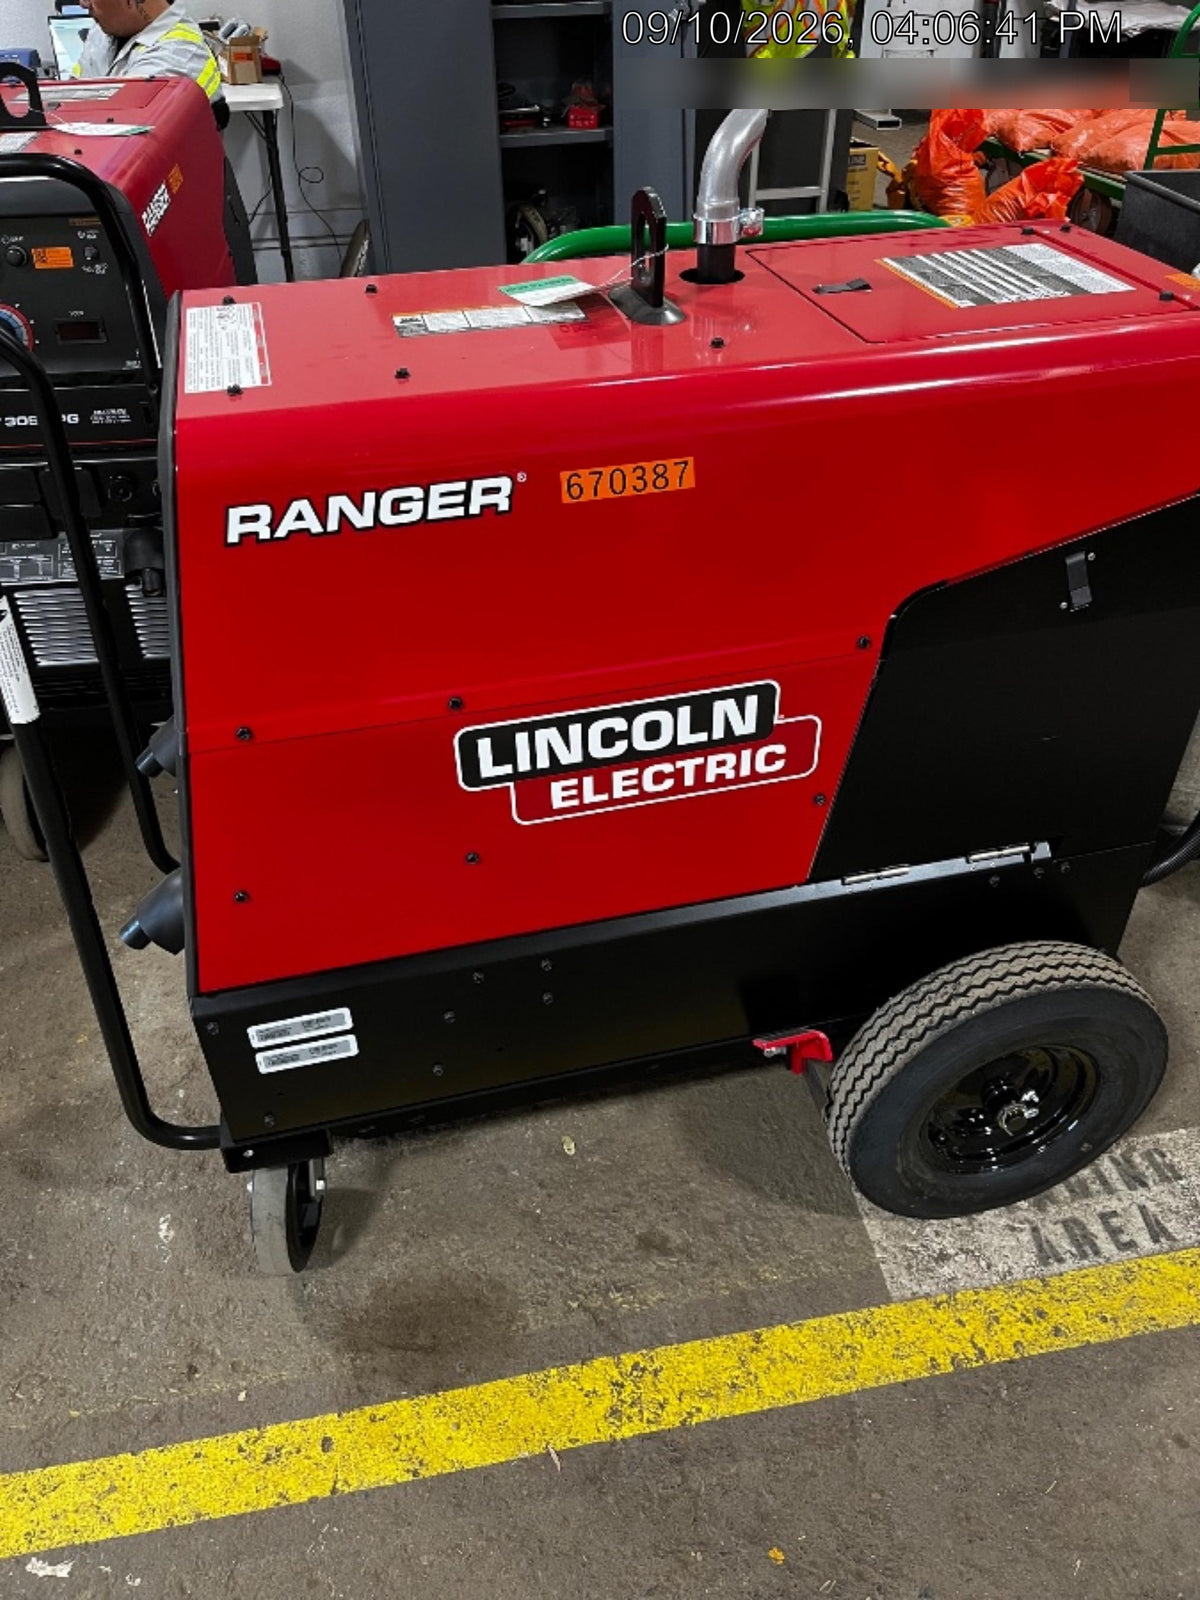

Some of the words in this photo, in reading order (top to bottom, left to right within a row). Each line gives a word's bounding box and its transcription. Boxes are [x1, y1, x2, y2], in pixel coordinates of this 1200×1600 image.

[565, 459, 690, 500] 670387
[477, 694, 758, 779] LINCOLN
[551, 743, 787, 810] ELECTRIC
